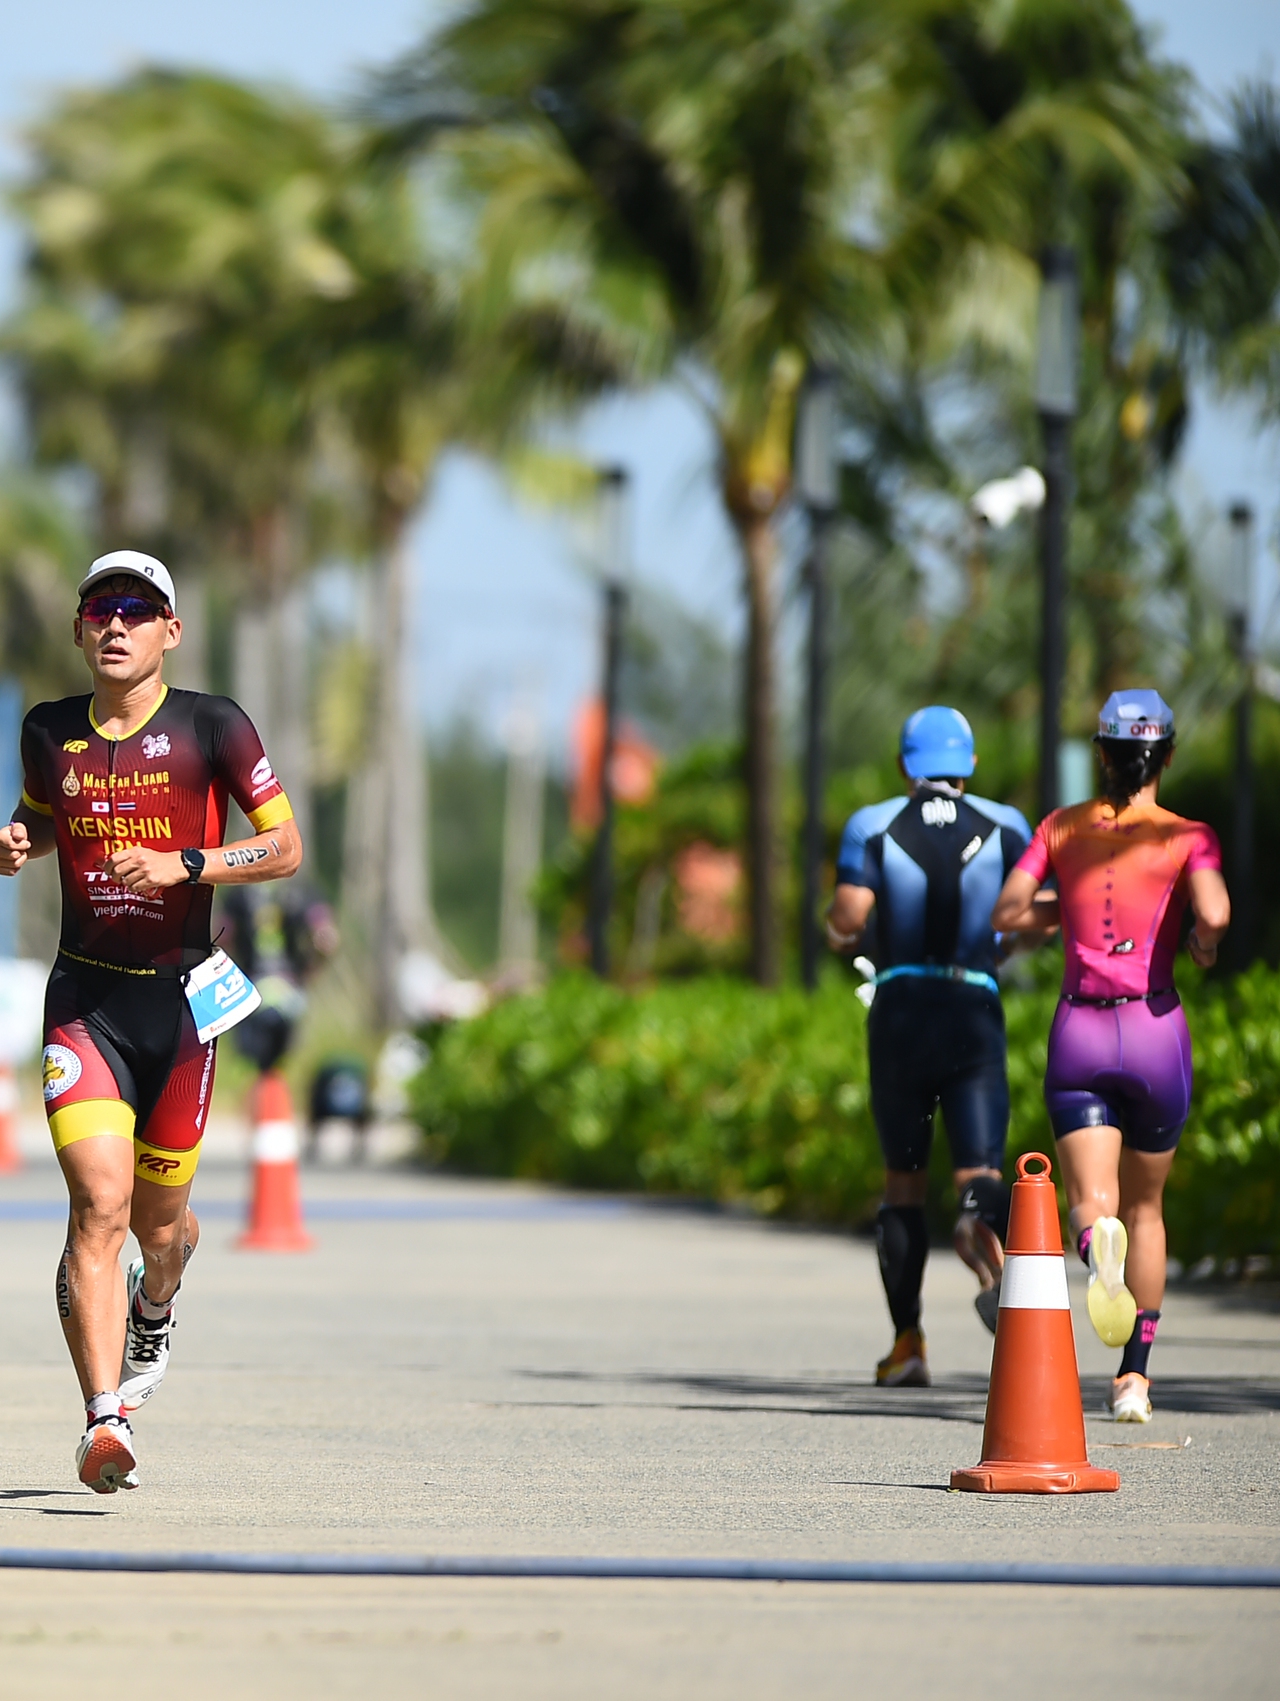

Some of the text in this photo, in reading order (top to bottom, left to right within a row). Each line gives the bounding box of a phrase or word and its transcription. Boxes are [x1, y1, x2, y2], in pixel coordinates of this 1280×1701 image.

[109, 773, 130, 789] FAH
[134, 770, 170, 787] LUANG
[83, 786, 170, 799] TRIATHLON
[68, 816, 173, 839] KENSHIN
